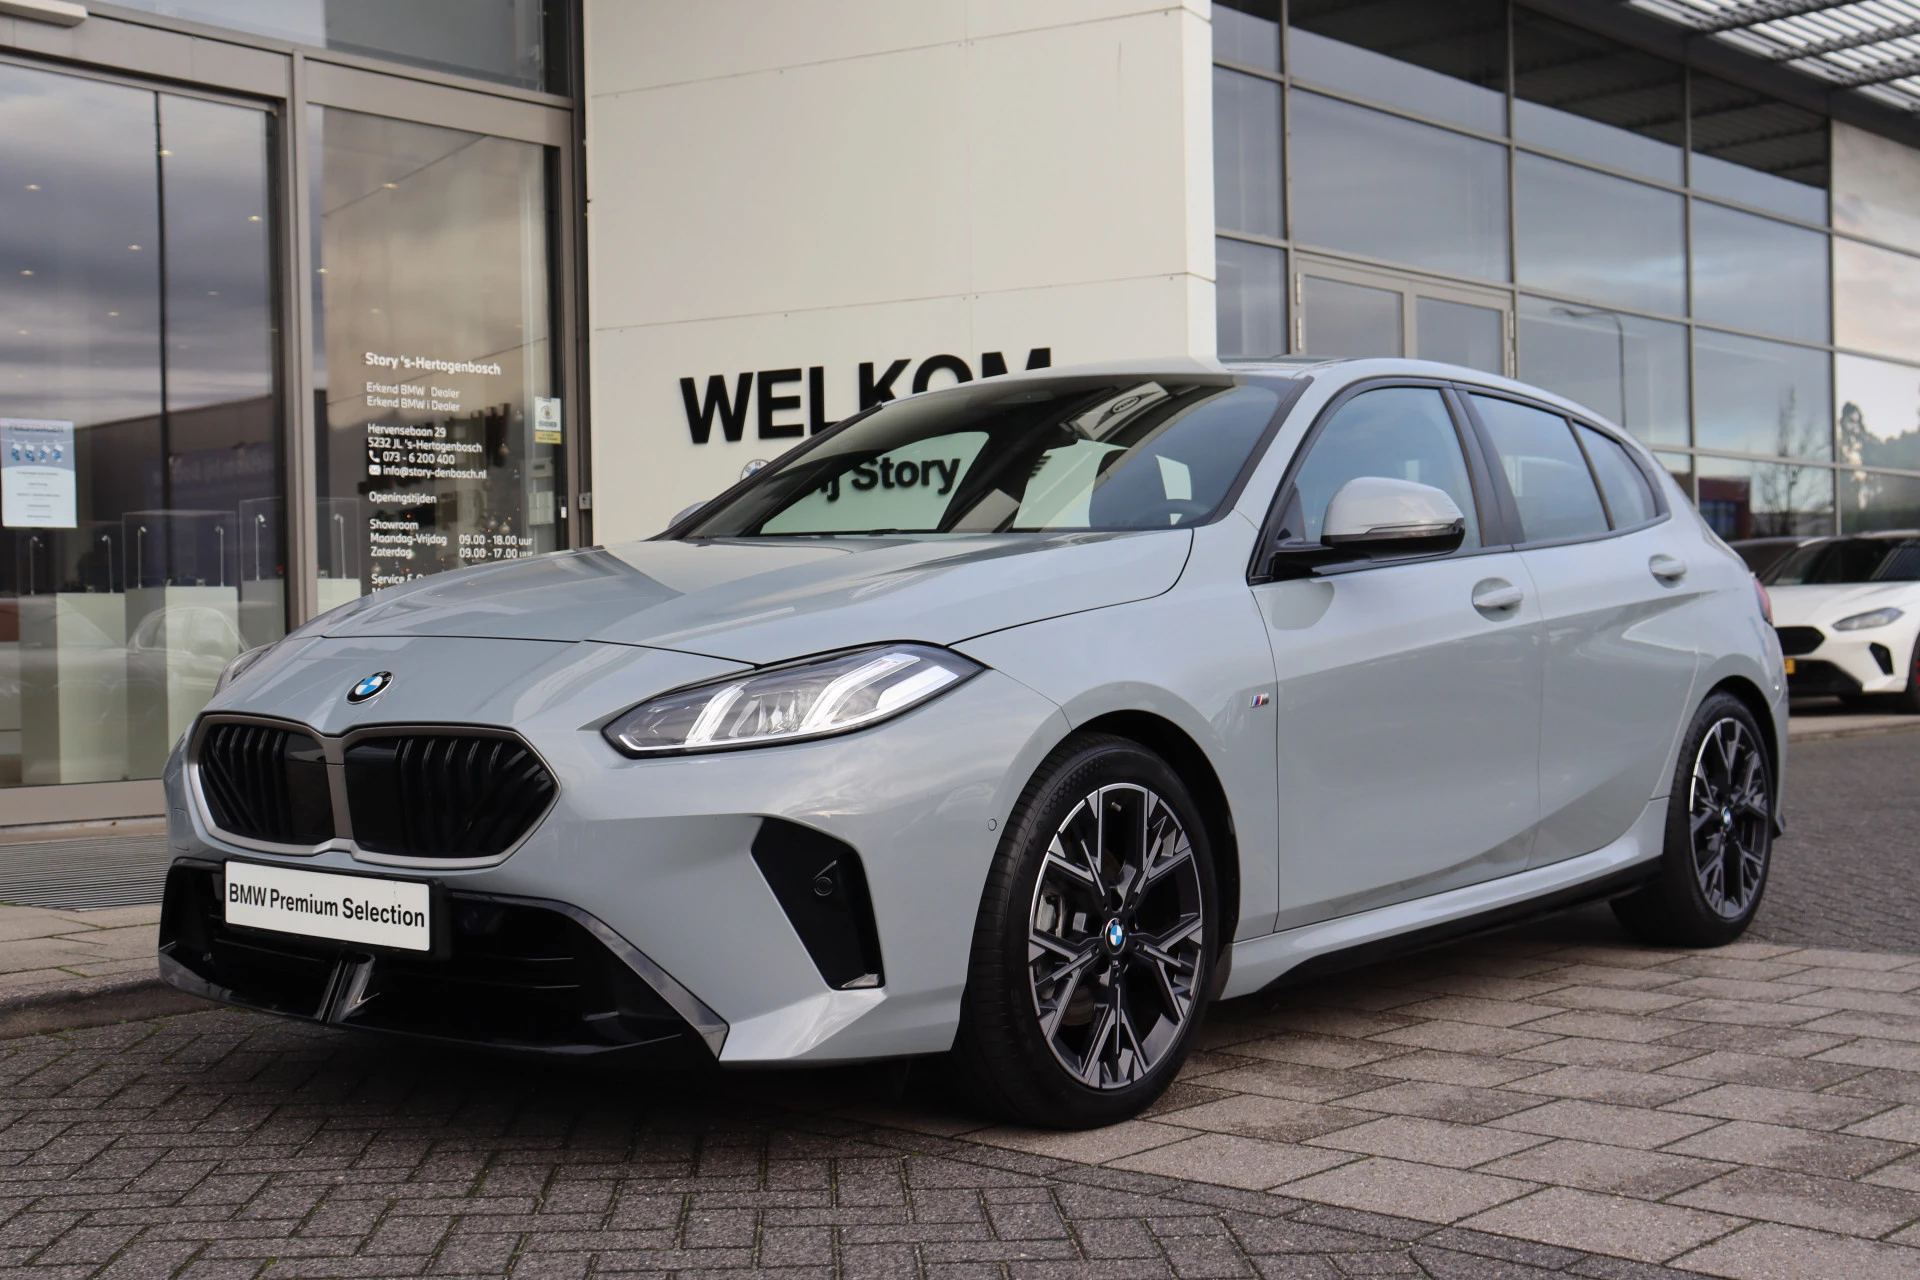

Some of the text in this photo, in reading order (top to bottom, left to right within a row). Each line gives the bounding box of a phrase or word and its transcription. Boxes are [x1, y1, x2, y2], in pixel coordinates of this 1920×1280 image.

[365, 351, 501, 375] Story 's-Hertogenbosch
[366, 381, 460, 398] Erkend BMW Dealer
[366, 395, 399, 408] Erkend
[400, 397, 425, 410] BMW
[431, 400, 460, 412] Dealer
[367, 423, 447, 438] Hervensebaan 29
[368, 436, 482, 453] 5232 JL 's-Hertogenbosch
[382, 451, 400, 462] 073
[408, 452, 416, 463] 6
[417, 453, 435, 464] 200
[437, 454, 455, 465] 400
[383, 465, 487, 479] info@story-denbosch.nl
[851, 457, 961, 495] Story
[369, 491, 437, 505] Openingstijden
[369, 518, 419, 530] Showroom
[370, 532, 448, 546] Maandag-Vrijdag
[459, 534, 486, 545] 09.00
[493, 535, 517, 545] 18.00
[370, 546, 413, 559] Zaterdag
[459, 547, 486, 558] 09.00
[494, 548, 518, 558] 17.00
[371, 573, 405, 584] Service
[229, 883, 425, 927] BMW Premium Selection
